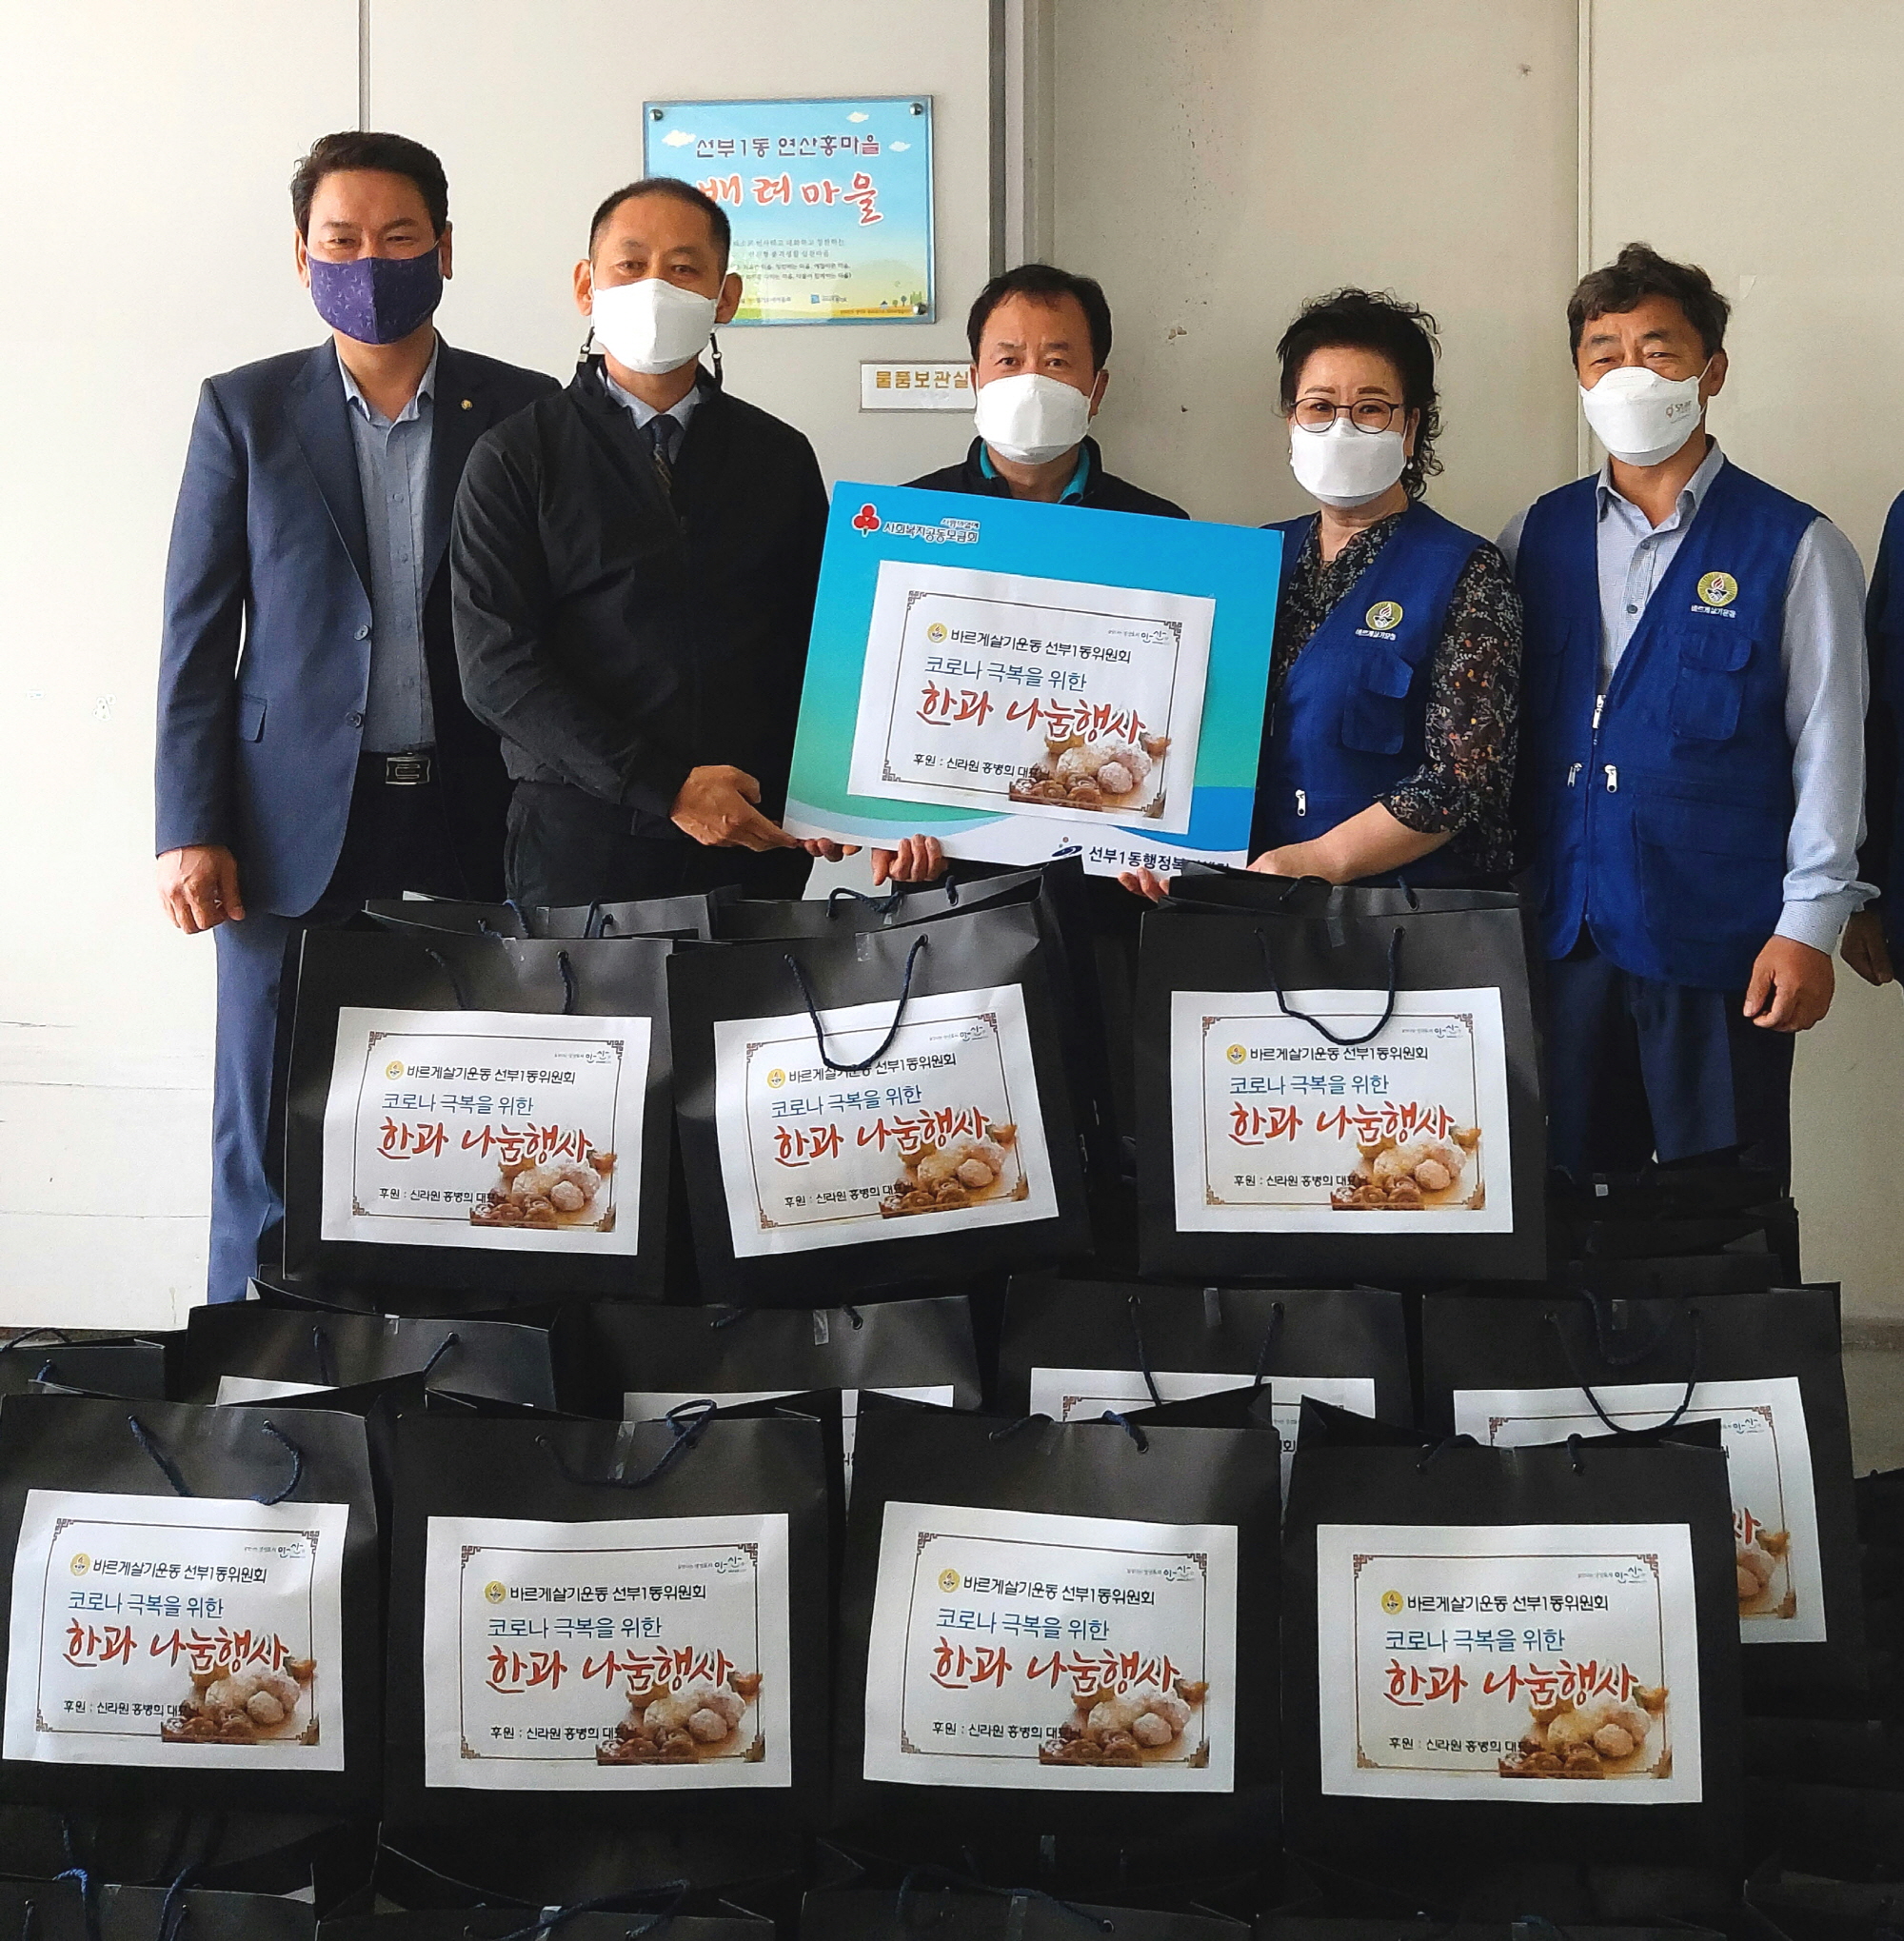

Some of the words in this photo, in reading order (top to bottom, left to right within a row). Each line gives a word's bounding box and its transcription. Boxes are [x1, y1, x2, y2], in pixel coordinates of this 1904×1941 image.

[697, 138, 770, 158] 선부1동
[778, 135, 879, 156] 연산홍마을
[876, 370, 969, 389] 물품보관실
[884, 523, 978, 543] 사회복지공동모금회
[1355, 627, 1397, 641] 바르게살기운동
[951, 629, 1041, 653] 바르게살기운동
[1045, 643, 1131, 664] 선부1동위원회
[925, 656, 982, 679] 코로나
[987, 663, 1043, 687] 극복을
[1048, 670, 1087, 692] 위한
[917, 681, 993, 726] 한과
[1006, 699, 1146, 744] 나눔행사
[913, 753, 936, 766] 후원
[947, 757, 979, 773] 신라원
[982, 762, 1015, 777] 홍병희
[1089, 845, 1229, 872] 선부1동행정복
[875, 1054, 956, 1075] 선부1동위원회
[1251, 1047, 1339, 1061] 바르게살기운동
[1344, 1046, 1428, 1060] 선부1동위원회
[407, 1065, 491, 1081] 바르게살기운동
[494, 1068, 575, 1084] 선부1동위원회
[1230, 1076, 1285, 1095] 코로나
[1290, 1075, 1346, 1095] 극복을
[1352, 1075, 1389, 1094] 위한
[382, 1094, 436, 1112] 코로나
[440, 1095, 493, 1114] 극복을
[498, 1097, 534, 1116] 위한
[771, 1095, 823, 1119] 코로나
[828, 1090, 881, 1113] 극복을
[887, 1085, 922, 1106] 위한
[1228, 1101, 1302, 1145] 한과
[1317, 1100, 1455, 1143] 나눔행사
[377, 1117, 448, 1160] 한과
[462, 1122, 594, 1165] 나눔행사
[774, 1124, 843, 1167] 한과
[858, 1107, 989, 1152] 나눔행사
[1234, 1176, 1256, 1186] 후원
[1266, 1175, 1298, 1186] 신라원
[1301, 1176, 1333, 1186] 홍병희
[379, 1188, 400, 1199] 후원
[410, 1190, 441, 1201] 신라원
[444, 1191, 473, 1203] 홍병희
[784, 1196, 805, 1207] 후원
[816, 1192, 846, 1204] 신라원
[849, 1188, 880, 1201] 홍병희
[93, 1559, 180, 1578] 바르게살기운동
[185, 1566, 267, 1583] 선부1동위원회
[510, 1587, 608, 1602] 바르게살기운동
[612, 1585, 706, 1601] 선부1동위원회
[963, 1576, 1058, 1599] 바르게살기운동
[1062, 1586, 1154, 1605] 선부1동위원회
[68, 1592, 122, 1614] 코로나
[128, 1594, 181, 1615] 극복을
[187, 1597, 223, 1618] 위한
[1407, 1595, 1506, 1612] 바르게살기운동
[1513, 1594, 1608, 1612] 선부1동위원회
[487, 1618, 548, 1638] 코로나
[554, 1617, 615, 1638] 극복을
[621, 1617, 662, 1637] 위한
[937, 1608, 997, 1633] 코로나
[1002, 1614, 1061, 1639] 극복을
[1067, 1618, 1109, 1641] 위한
[63, 1617, 137, 1667] 한과
[150, 1626, 289, 1672] 나눔행사
[1385, 1629, 1448, 1652] 코로나
[1454, 1629, 1516, 1652] 극복을
[1523, 1628, 1564, 1651] 위한
[486, 1645, 567, 1693] 한과
[583, 1645, 733, 1693] 나눔행사
[930, 1635, 1012, 1689] 한과
[1027, 1648, 1180, 1693] 나눔행사
[1383, 1658, 1468, 1706] 한과
[1483, 1658, 1639, 1706] 나눔행사
[64, 1700, 86, 1713] 후원
[97, 1702, 129, 1715] 신라원
[132, 1703, 164, 1716] 홍병희
[491, 1727, 514, 1739] 후원
[526, 1727, 561, 1740] 신라원
[564, 1727, 599, 1740] 홍병희
[932, 1722, 957, 1734] 후원
[968, 1724, 1003, 1737] 신라원
[1008, 1725, 1042, 1738] 홍병희
[1389, 1737, 1413, 1750] 후원
[1426, 1737, 1462, 1752] 신라원
[1465, 1739, 1501, 1753] 홍병희
